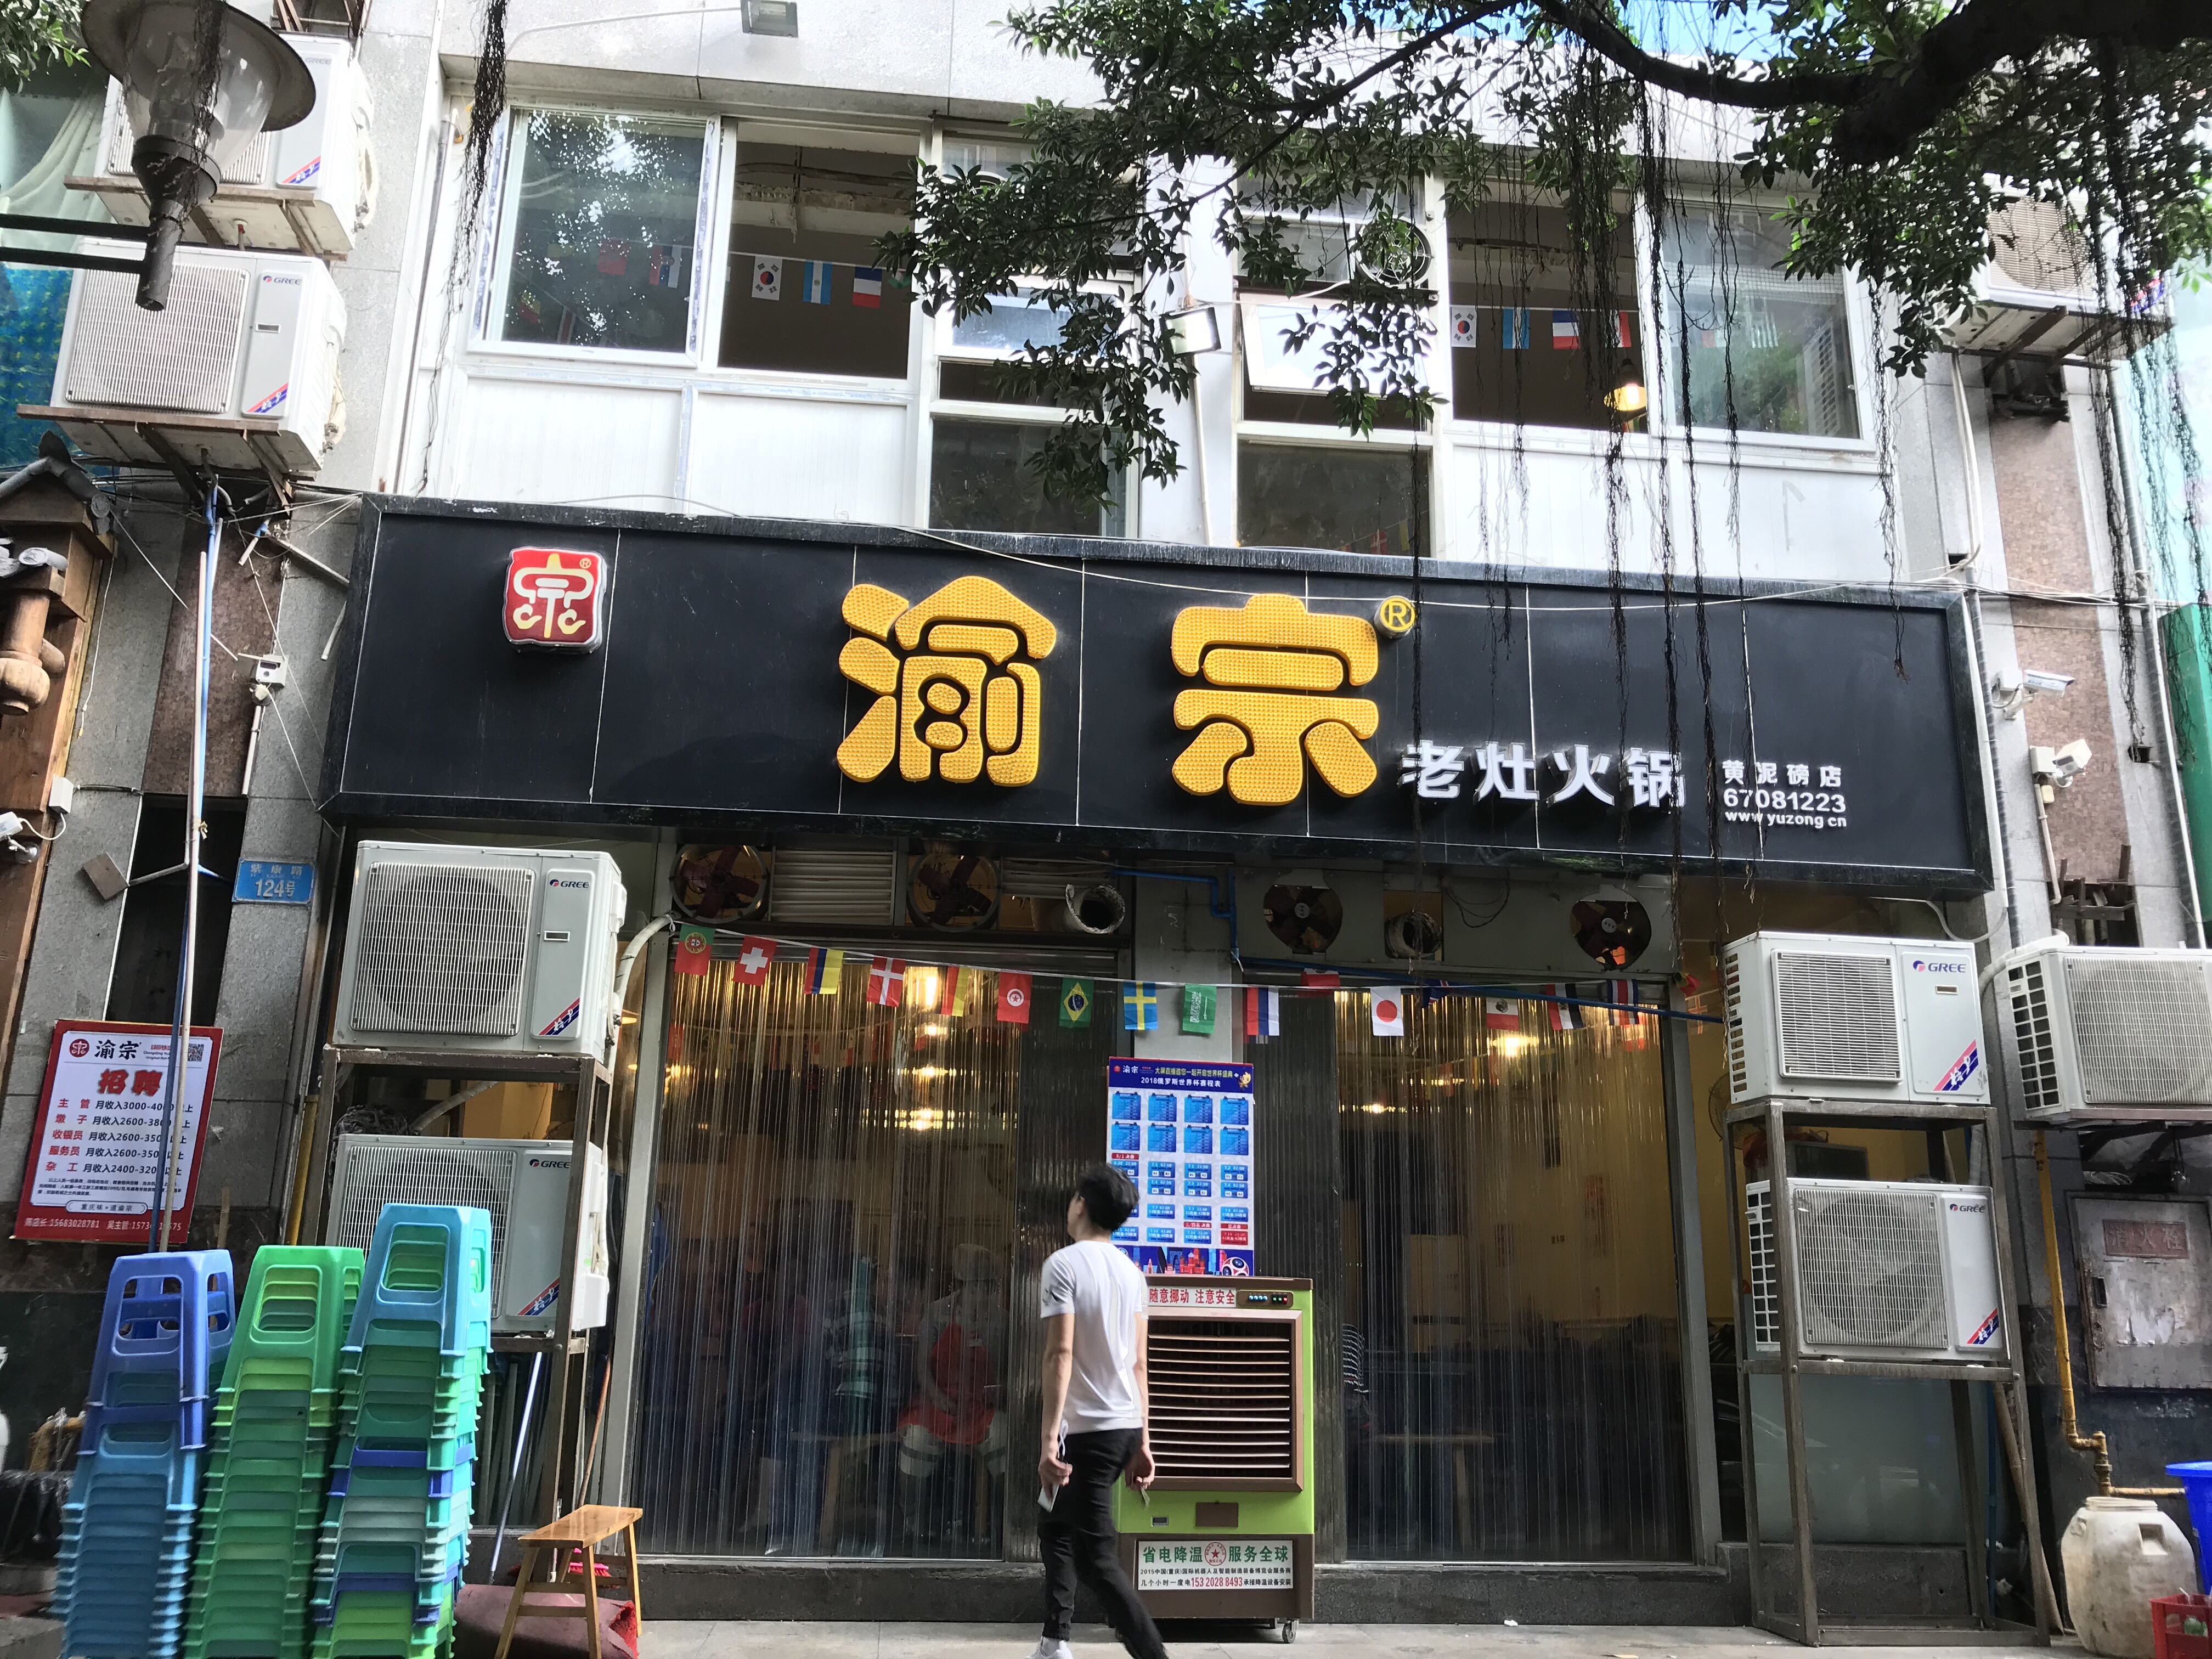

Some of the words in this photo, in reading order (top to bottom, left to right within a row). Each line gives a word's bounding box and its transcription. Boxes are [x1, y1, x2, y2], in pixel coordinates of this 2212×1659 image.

[837, 575, 1379, 805] 渝宗
[1402, 740, 1686, 808] 老灶火锅
[1722, 760, 1842, 787] 黄泥磅店
[1723, 788, 1846, 813] 67081223
[255, 879, 295, 898] 124号
[1928, 963, 1967, 973] GREE
[94, 1039, 138, 1060] 渝宗
[97, 1069, 163, 1097] 招聘
[1141, 1077, 1221, 1087] 2018俄罗斯世界杯赛程表
[58, 1098, 91, 1109] 主管
[52, 1130, 83, 1140] 收银员
[49, 1146, 80, 1156] 服务员
[46, 1161, 78, 1172] 杂工
[541, 1160, 571, 1169] GREE
[1960, 1204, 1985, 1213] GREE
[1149, 1288, 1189, 1304] 随意挪动
[1195, 1289, 1235, 1305] 注意安全
[1143, 1546, 1203, 1563] 省电降温
[1228, 1545, 1288, 1562] 服务全球
[1191, 1577, 1204, 1587] 153
[1206, 1577, 1223, 1587] 2028
[1225, 1577, 1243, 1587] 8493
